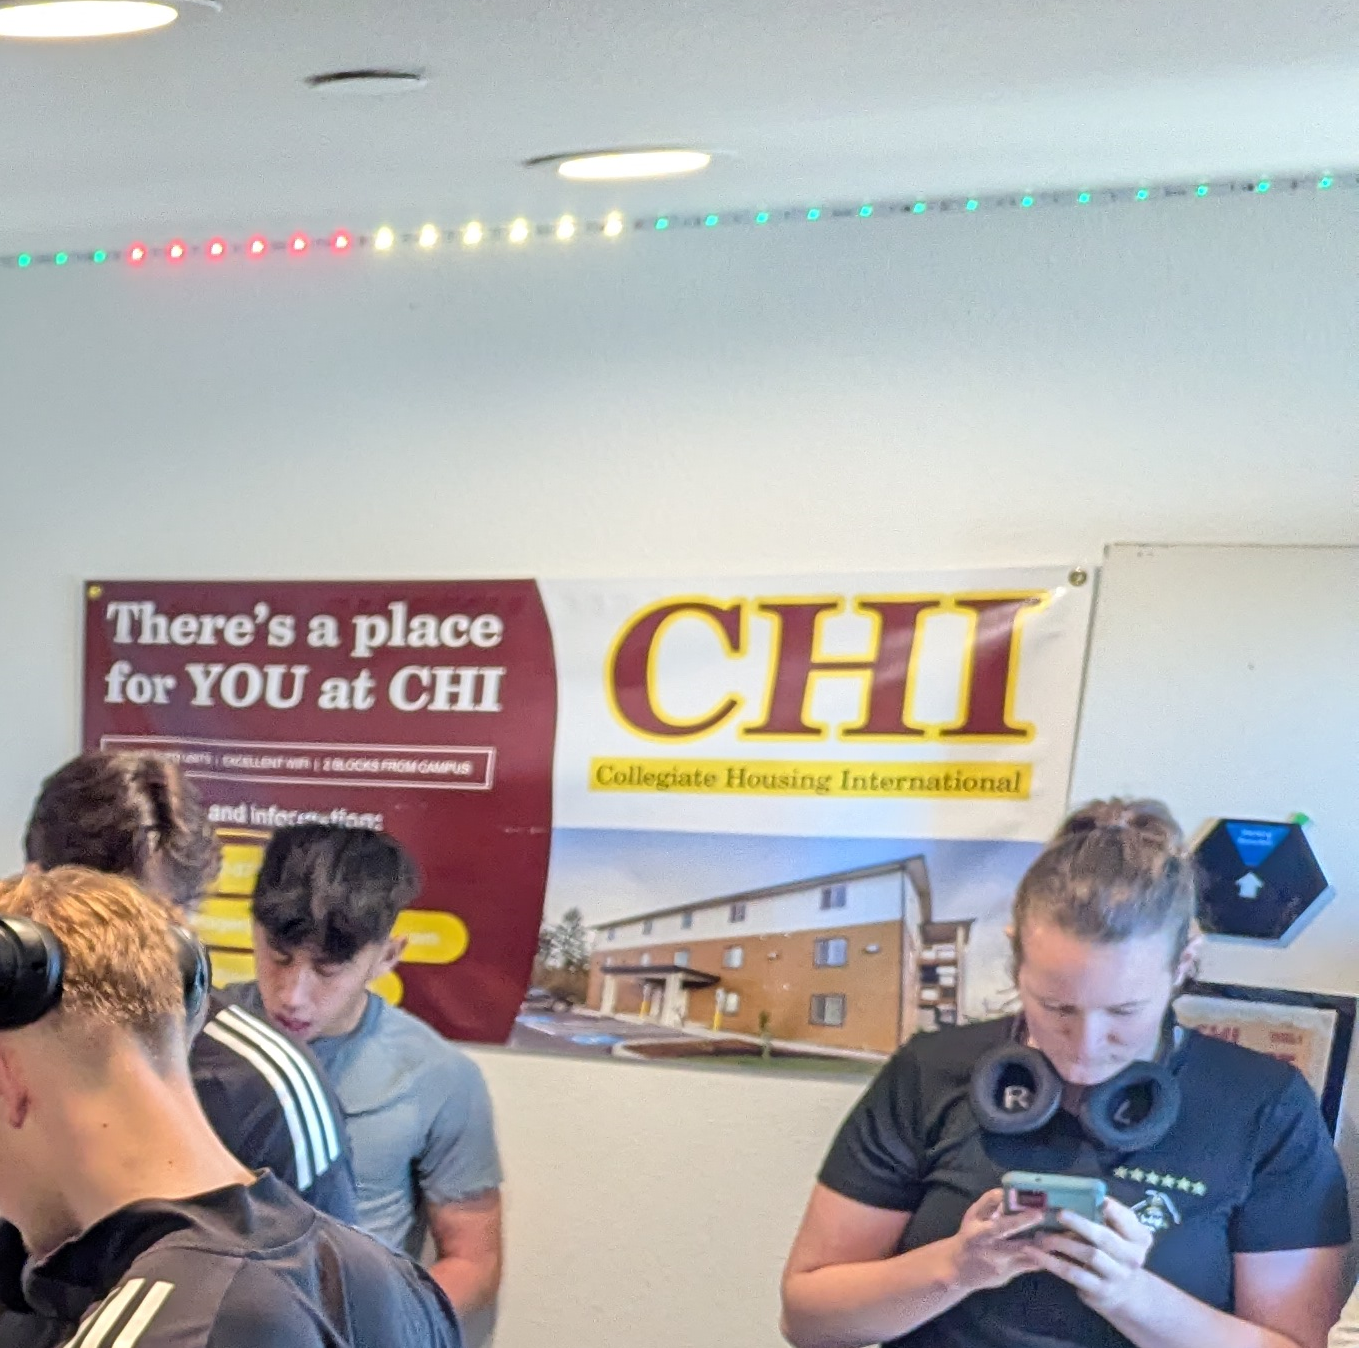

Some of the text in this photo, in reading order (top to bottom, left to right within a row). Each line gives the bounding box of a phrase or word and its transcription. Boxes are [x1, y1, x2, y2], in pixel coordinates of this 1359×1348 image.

[106, 601, 504, 658] There's a place
[604, 588, 1053, 744] CHI
[104, 659, 506, 712] for YOU at CHI
[222, 755, 281, 769] EXCELLENT
[333, 757, 379, 773] BLOCKS
[382, 759, 416, 774] FROM
[418, 761, 472, 776] CAMPUS
[595, 763, 1022, 796] Collegiate Housing International
[208, 803, 247, 824] and
[1004, 1085, 1029, 1110] R
